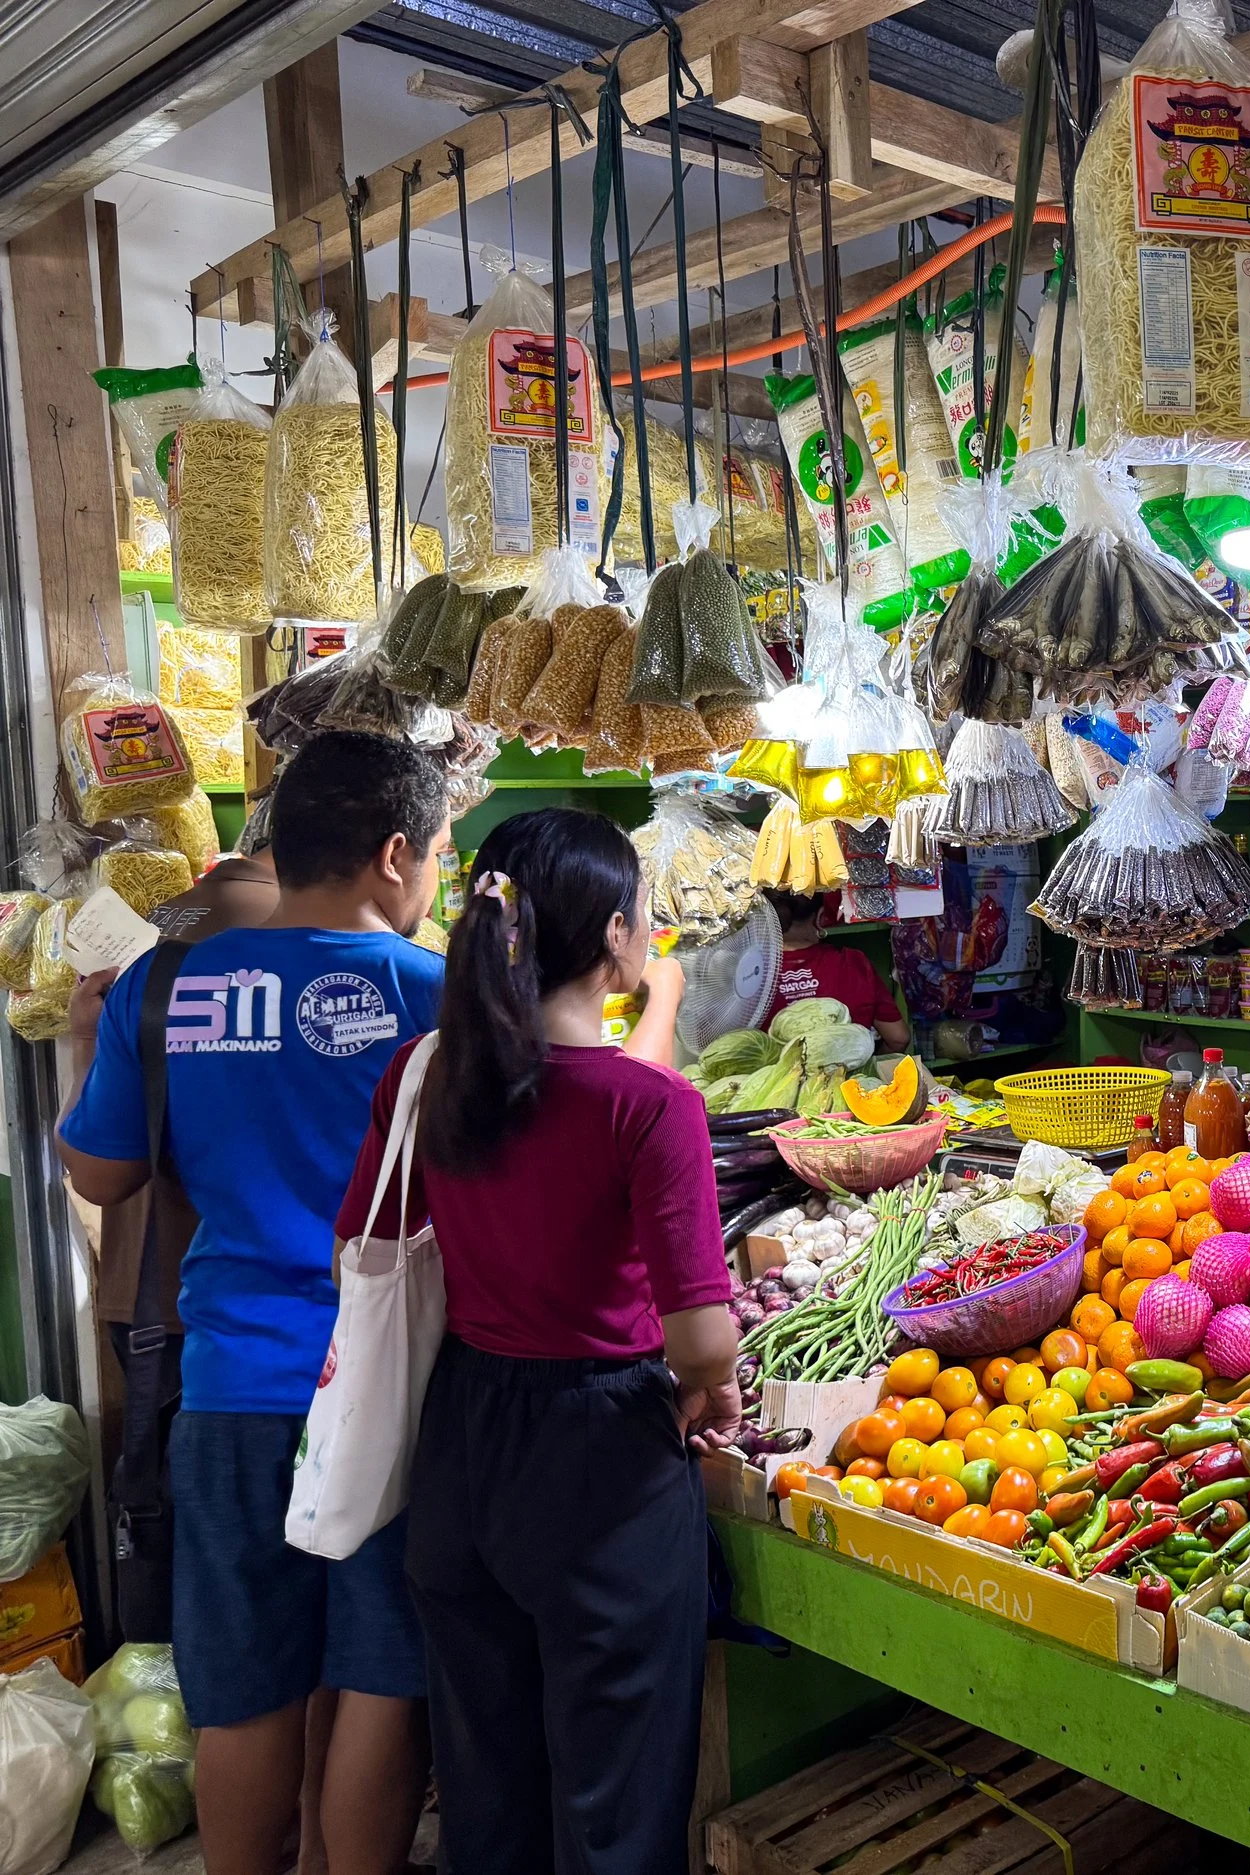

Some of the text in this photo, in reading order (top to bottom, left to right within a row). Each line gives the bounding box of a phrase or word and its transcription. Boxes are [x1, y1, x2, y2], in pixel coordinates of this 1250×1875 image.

[1141, 251, 1186, 260] Nutrition Facts
[779, 978, 820, 993] SIARGAO
[327, 1009, 376, 1025] SURIGAO
[335, 1022, 395, 1038] TATAK LYNDON
[196, 1039, 282, 1053] MAKINANO
[847, 1539, 1034, 1623] MANDARIN
